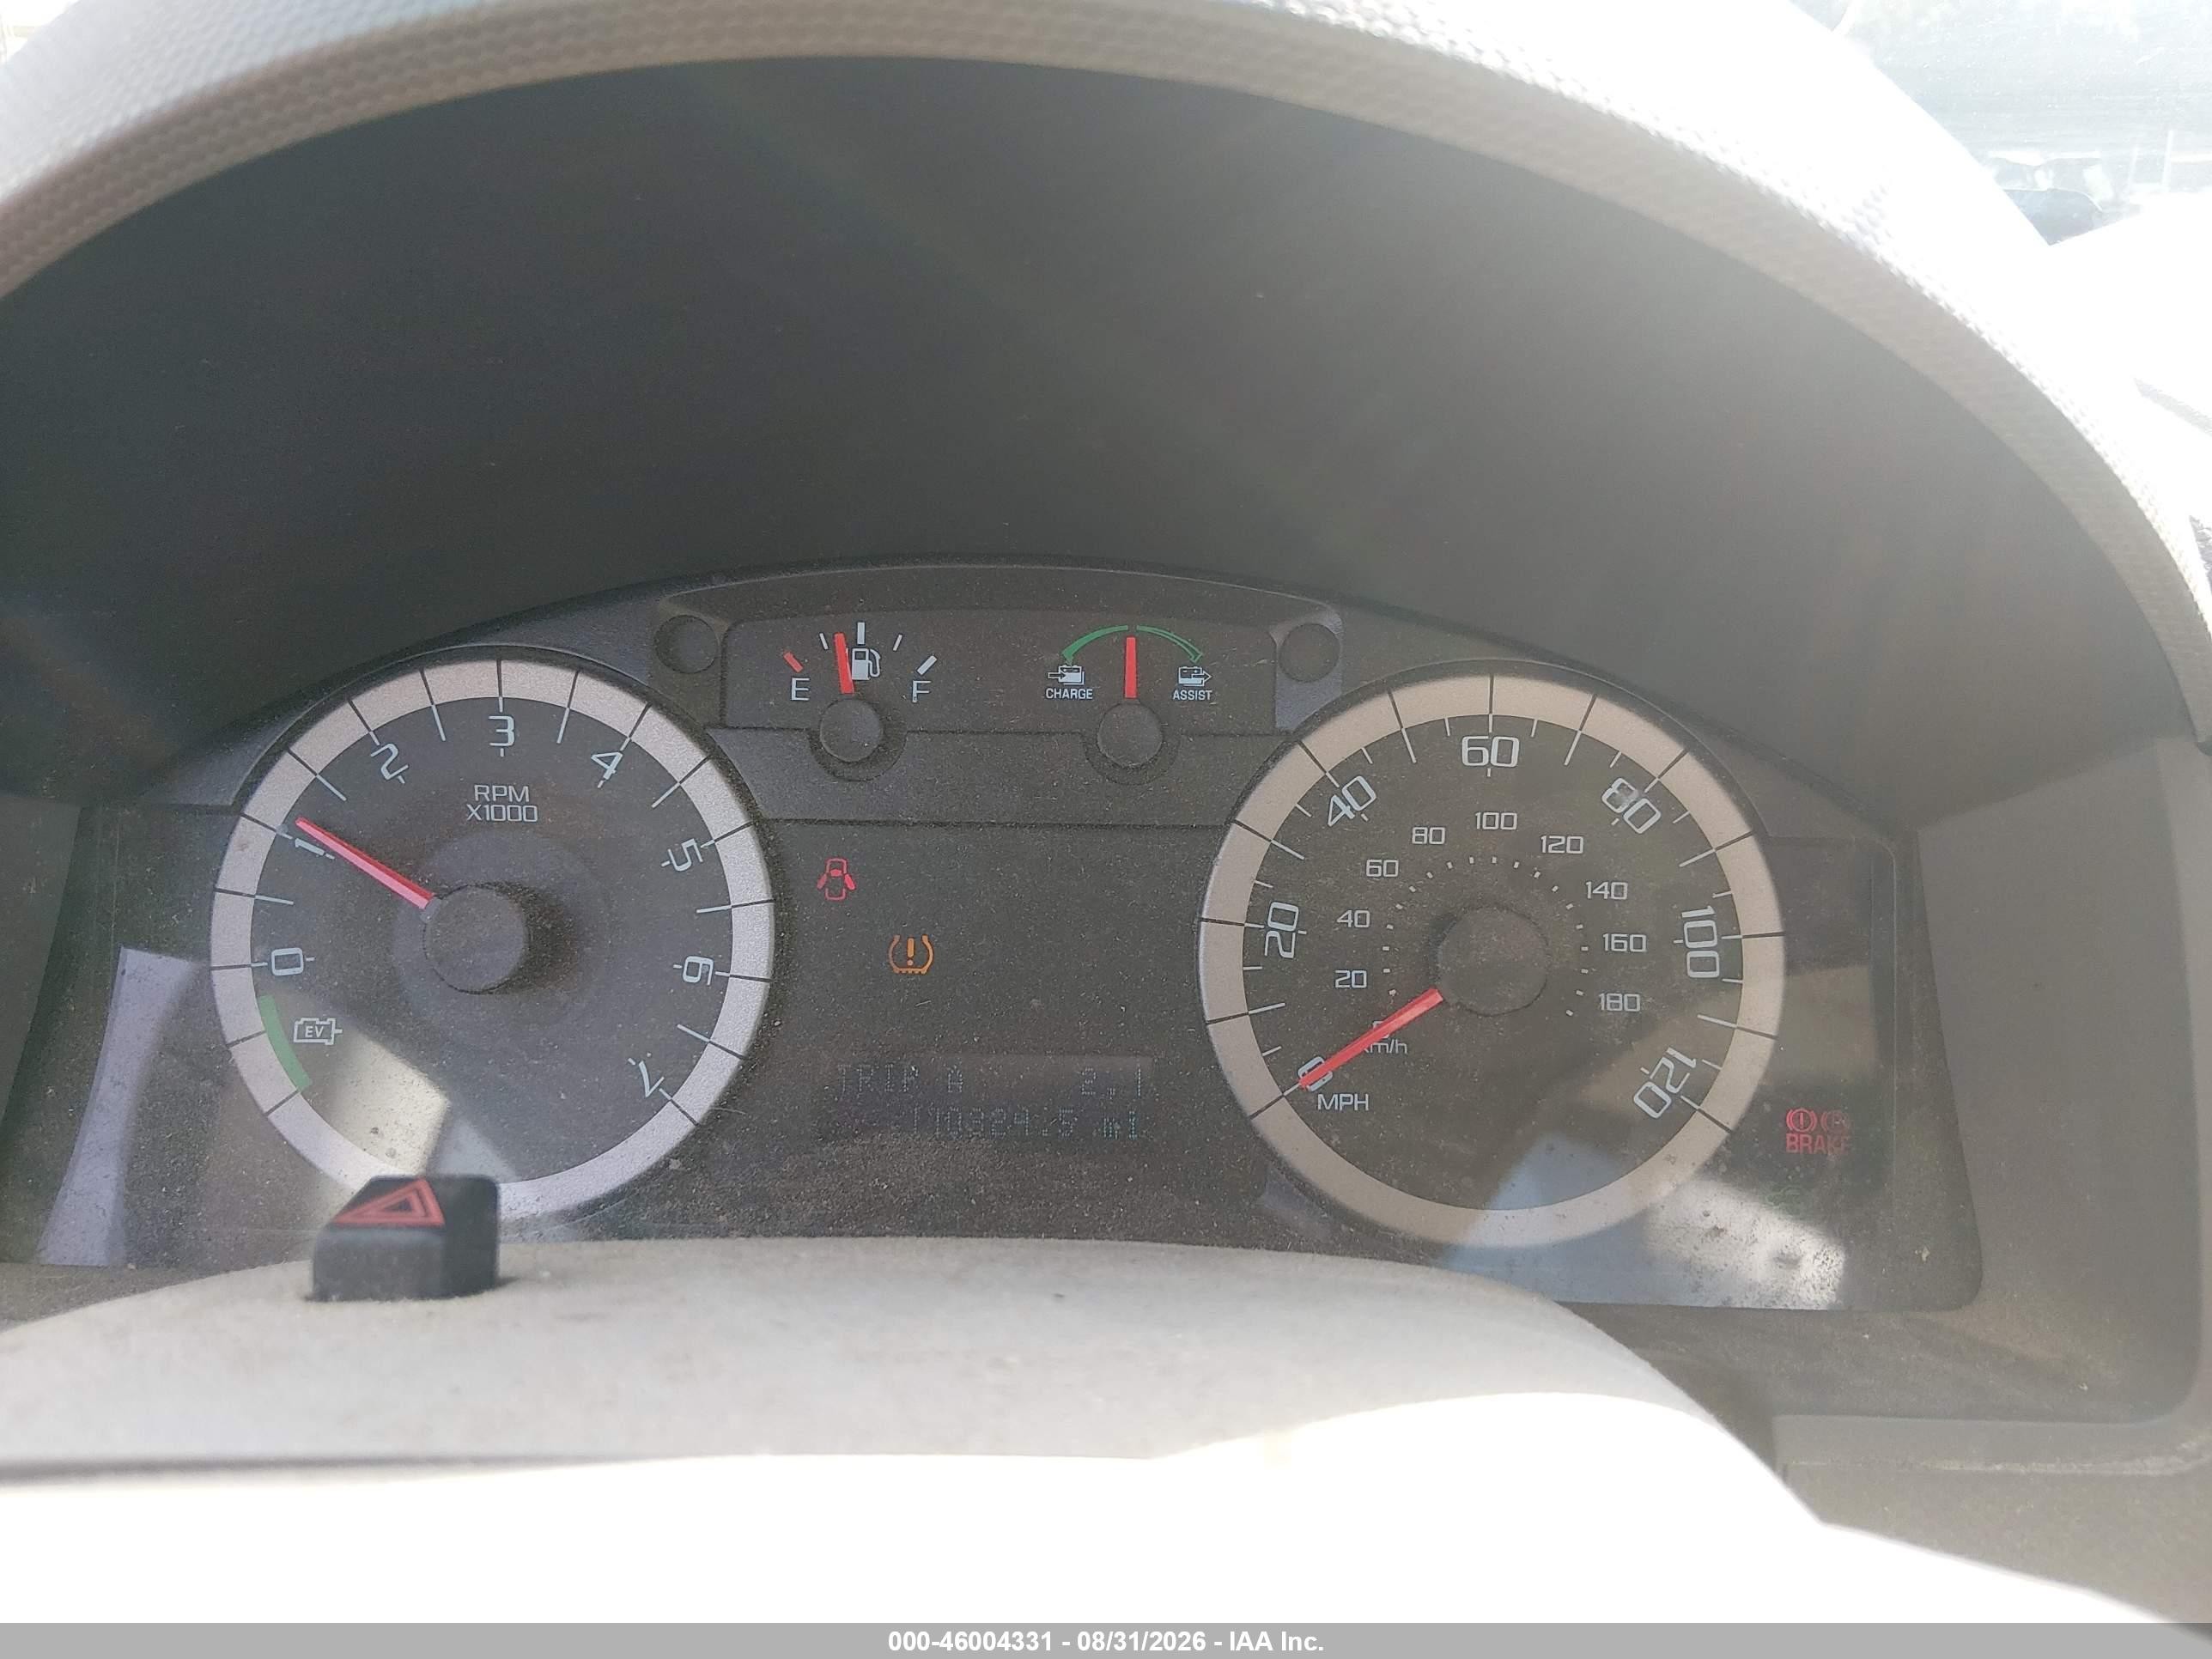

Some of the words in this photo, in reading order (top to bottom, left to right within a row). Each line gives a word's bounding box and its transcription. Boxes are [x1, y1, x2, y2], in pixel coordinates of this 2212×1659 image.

[791, 678, 810, 701] E
[912, 681, 930, 703] F
[1045, 687, 1093, 701] CHARGE
[1172, 690, 1212, 702] ASSIST
[489, 715, 514, 746] 3
[1462, 736, 1519, 768] 60
[370, 743, 409, 781] 2
[591, 750, 623, 780] 4
[474, 784, 530, 802] RPM
[1327, 775, 1377, 826] 40
[466, 804, 538, 823] X1000
[1601, 777, 1662, 834] 80
[1474, 812, 1517, 830] 100
[1412, 827, 1445, 844] 80
[1540, 836, 1583, 854] 120
[670, 838, 703, 872] 5
[1365, 860, 1399, 878] 60
[1585, 882, 1627, 900] 140
[1336, 910, 1370, 928] 40
[1264, 902, 1300, 958] 20
[1602, 933, 1646, 952] 160
[1680, 905, 1720, 979] 100
[270, 948, 304, 975] 0
[682, 955, 714, 986] 6
[1334, 970, 1368, 988] 20
[1598, 993, 1641, 1012] 180
[304, 1024, 325, 1040] EV
[1364, 1040, 1408, 1054] m/h
[640, 1061, 665, 1098] 7
[1633, 1048, 1696, 1118] 120
[1316, 1093, 1370, 1111] MPH
